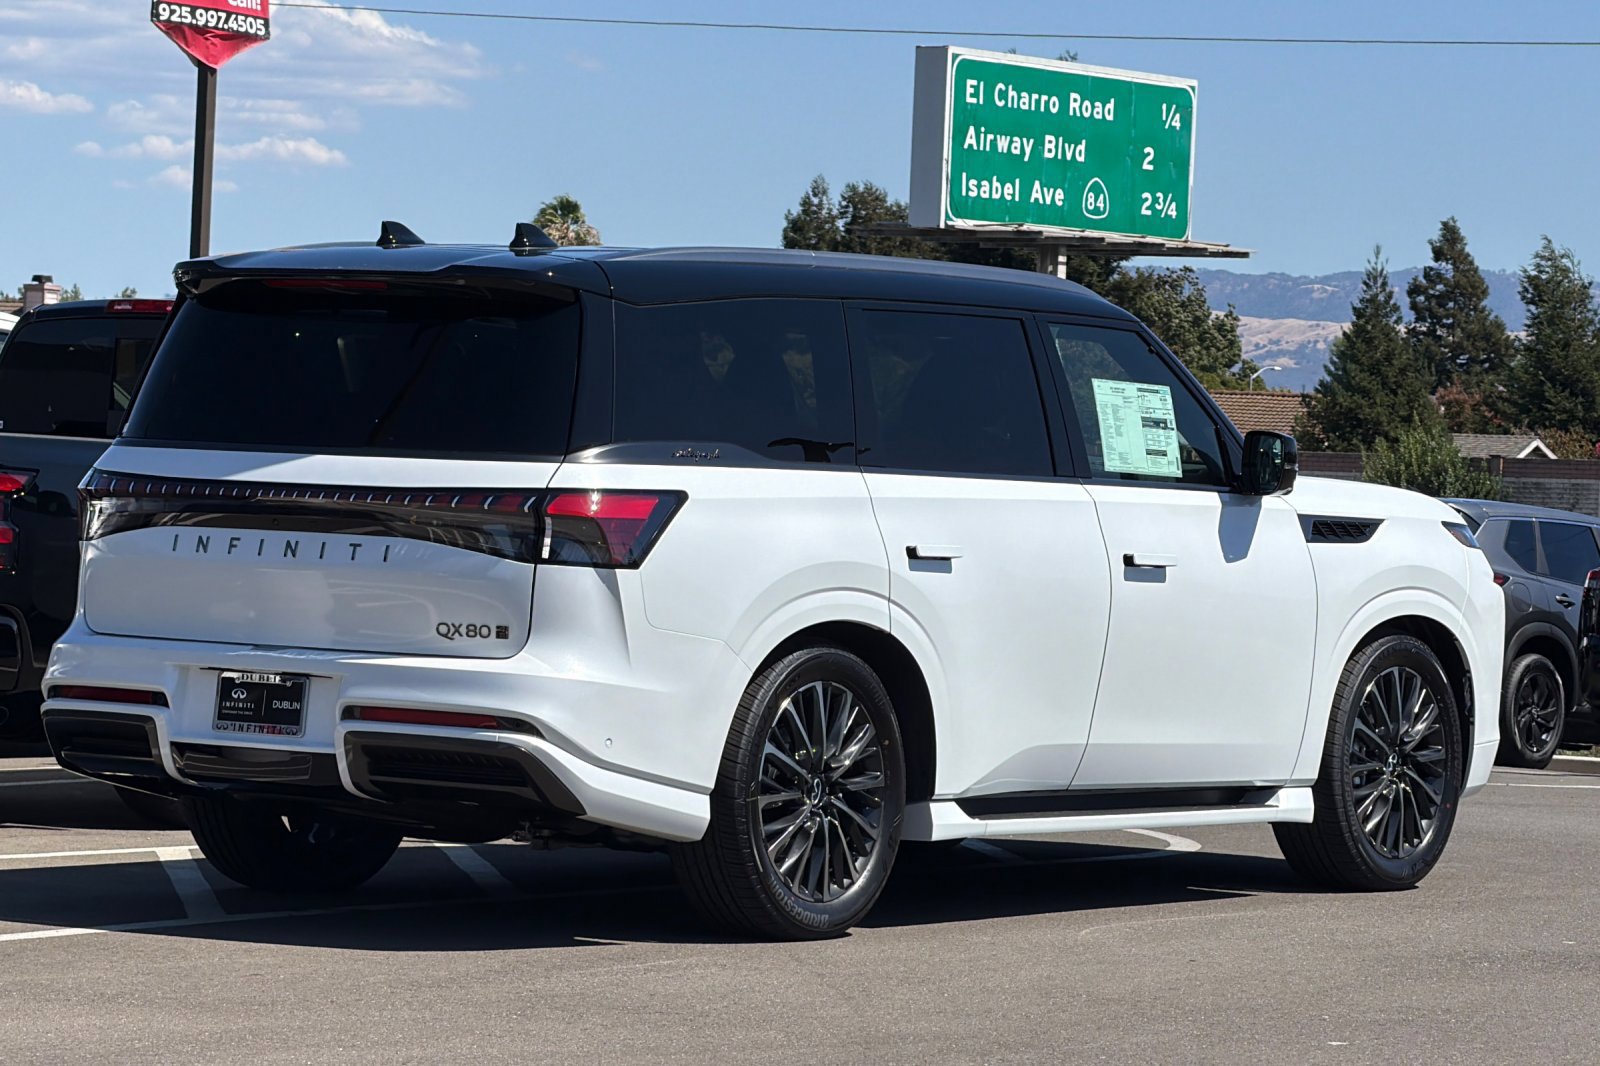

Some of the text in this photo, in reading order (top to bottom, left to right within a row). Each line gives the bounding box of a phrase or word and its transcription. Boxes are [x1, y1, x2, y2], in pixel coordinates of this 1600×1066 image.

[158, 3, 265, 35] 925.997.4505
[965, 79, 984, 105] El
[994, 83, 1059, 113] Charro
[1069, 92, 1115, 121] Road
[963, 125, 1155, 170] Airway Blvd 2
[961, 172, 1020, 202] Isabel
[1029, 180, 1065, 206] Ave
[1087, 191, 1105, 211] 84
[172, 533, 391, 562] INFINITI
[435, 622, 492, 640] QX80
[222, 700, 301, 710] INFINITI DUBLIN
